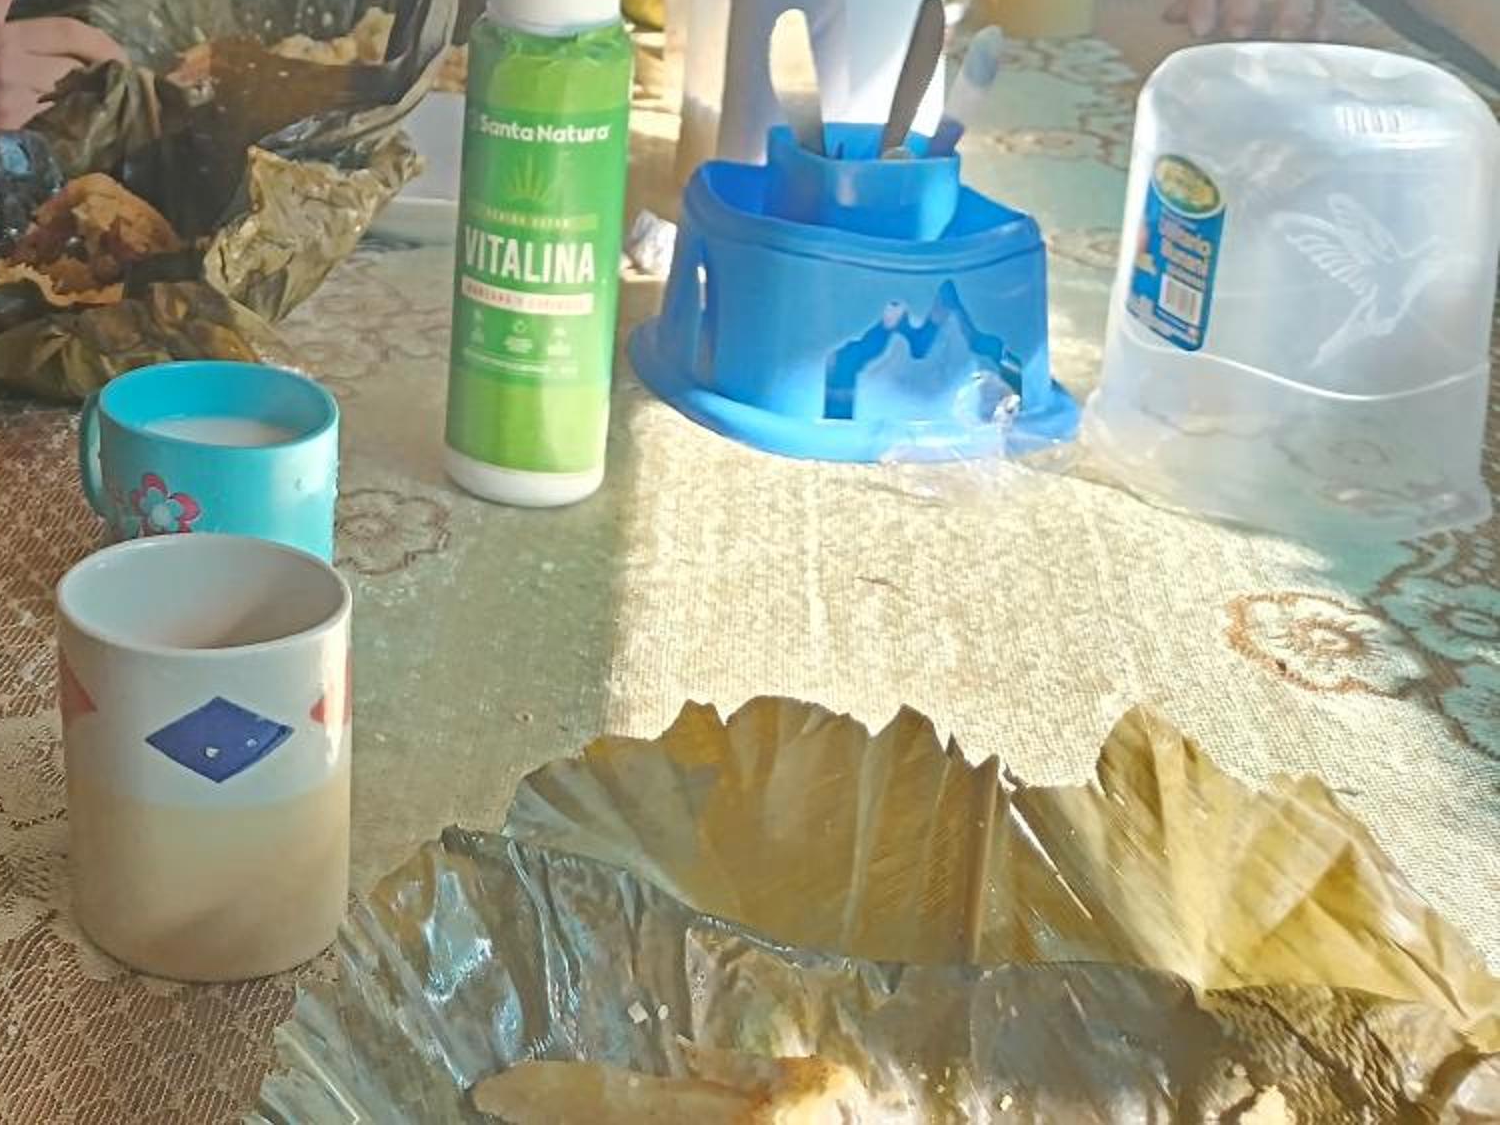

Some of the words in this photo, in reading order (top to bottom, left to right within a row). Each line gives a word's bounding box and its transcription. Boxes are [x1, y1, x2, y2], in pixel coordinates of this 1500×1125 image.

[480, 114, 533, 141] Santa
[537, 124, 611, 143] Natura
[464, 224, 596, 284] VITALINA
